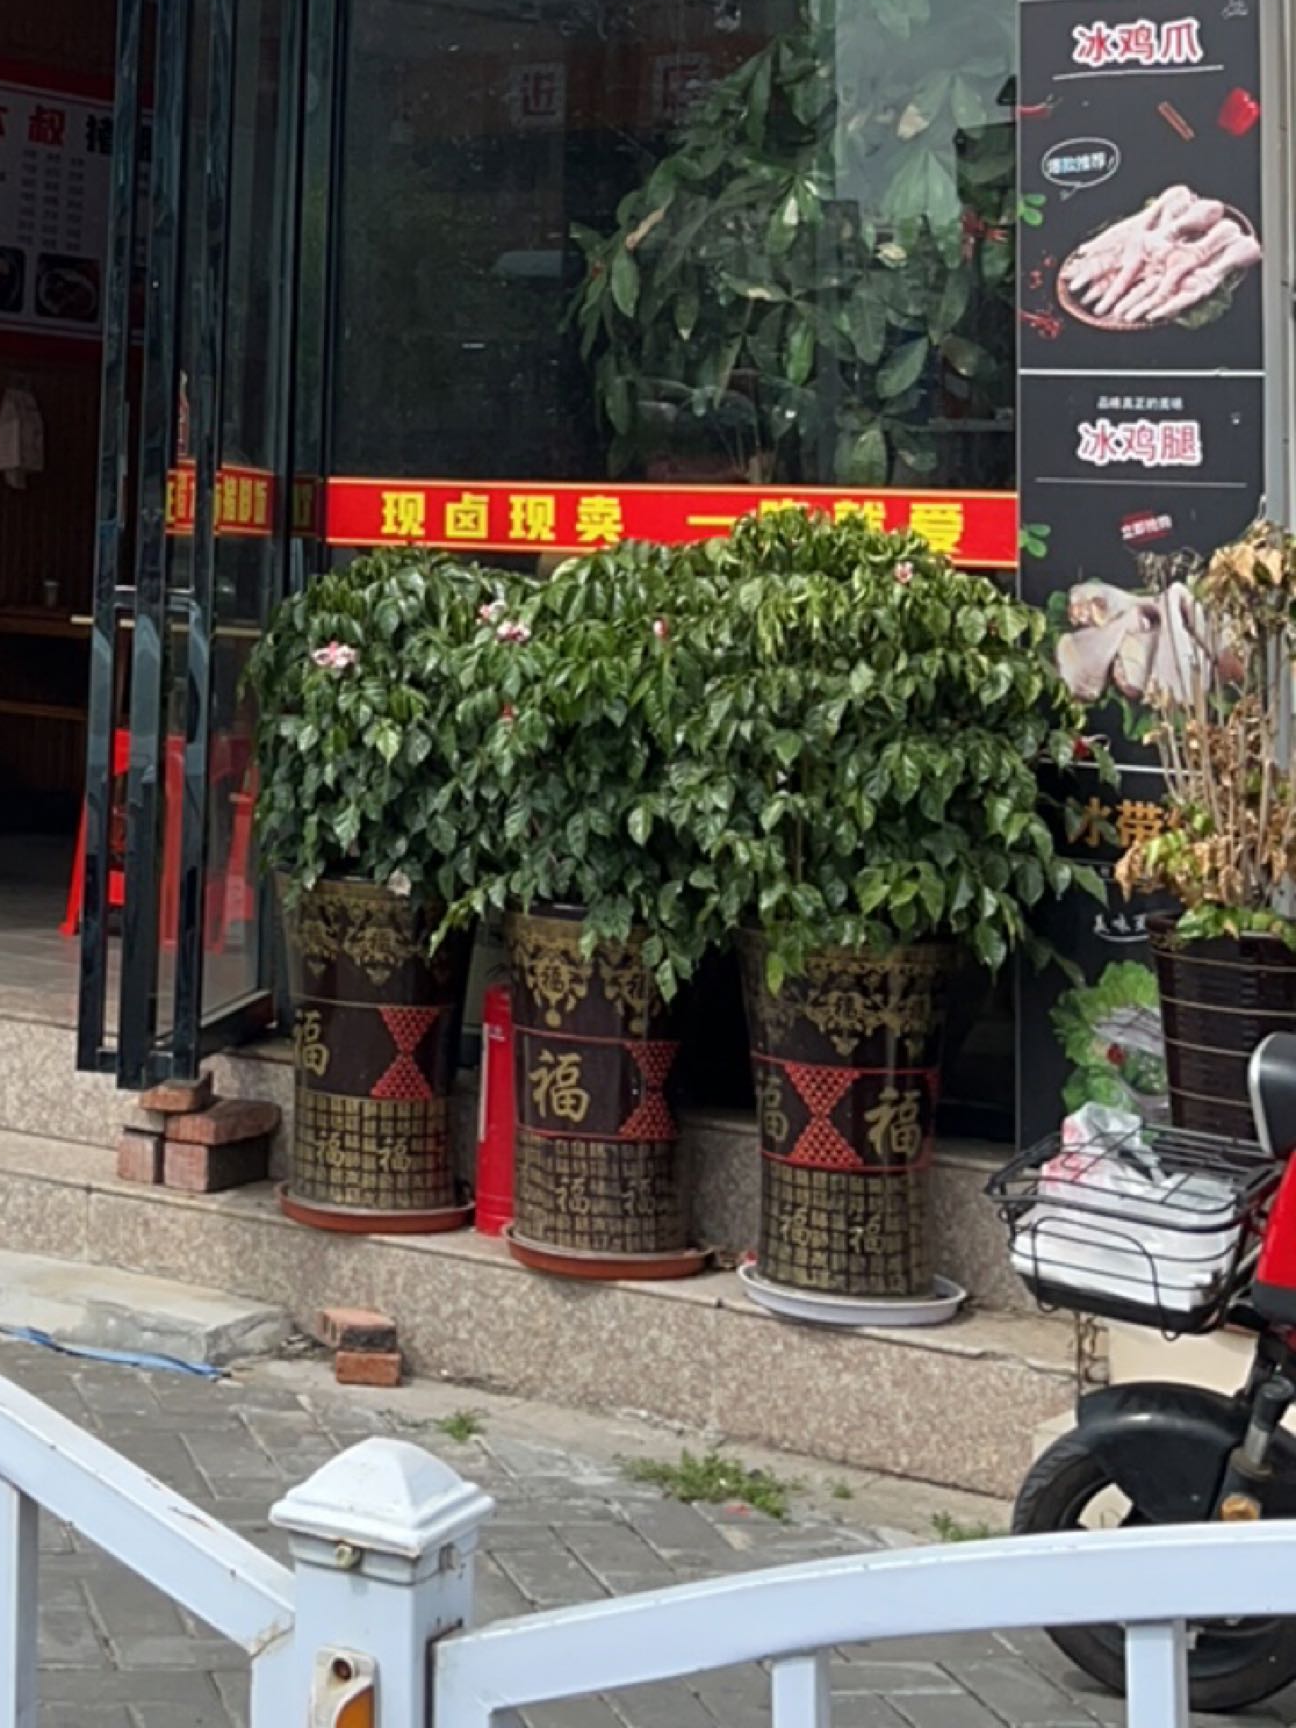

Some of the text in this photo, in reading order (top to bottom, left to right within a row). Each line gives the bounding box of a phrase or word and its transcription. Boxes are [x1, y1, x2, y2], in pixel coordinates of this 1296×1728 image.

[1072, 17, 1203, 66] 冰鸡爪
[1078, 417, 1202, 467] 冰鸡腿
[381, 491, 624, 543] 现卤现卖
[527, 1049, 592, 1124] 福
[864, 1086, 923, 1161] 福
